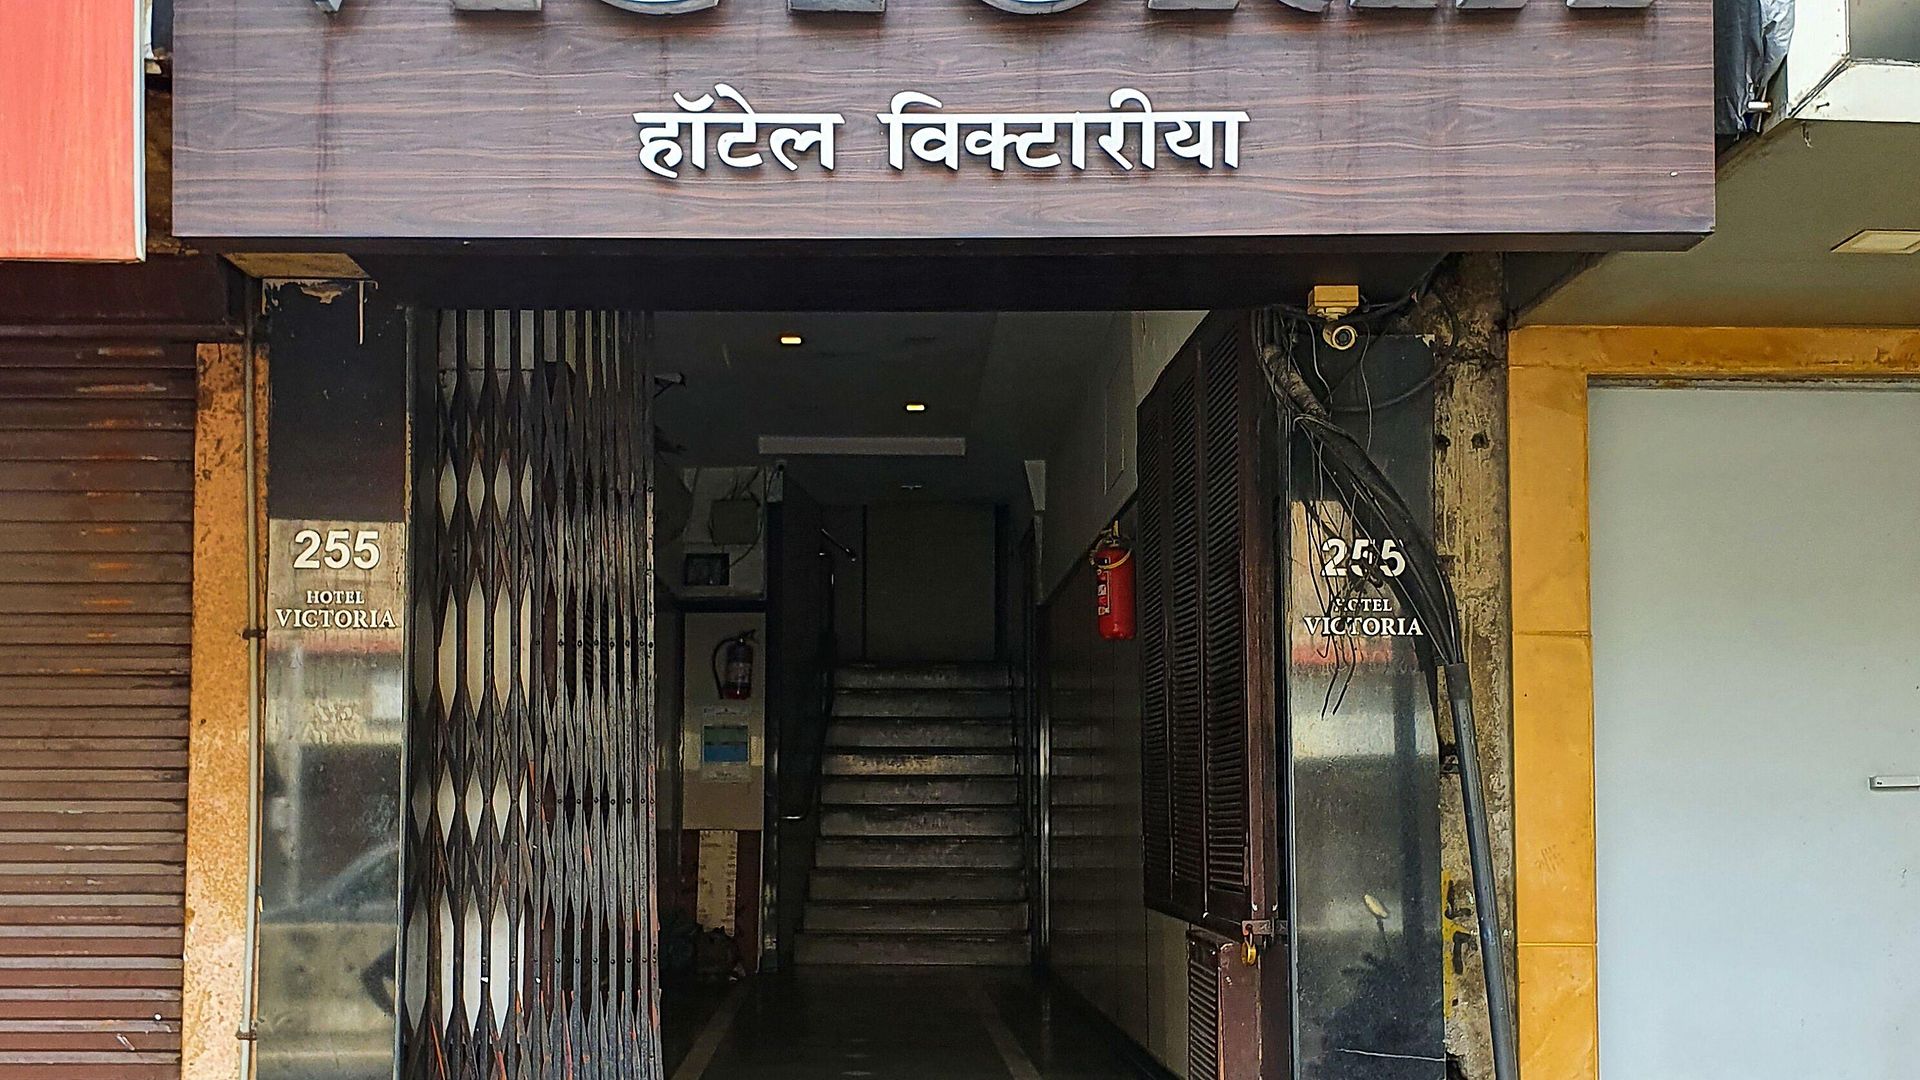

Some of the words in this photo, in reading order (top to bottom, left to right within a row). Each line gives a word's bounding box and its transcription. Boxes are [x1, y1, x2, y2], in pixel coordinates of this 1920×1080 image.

[633, 83, 845, 178] हॉटेल
[877, 88, 1250, 172] विक्टारीया
[293, 529, 381, 570] 255
[306, 590, 365, 605] HOTEL
[275, 608, 396, 628] VICTORIA
